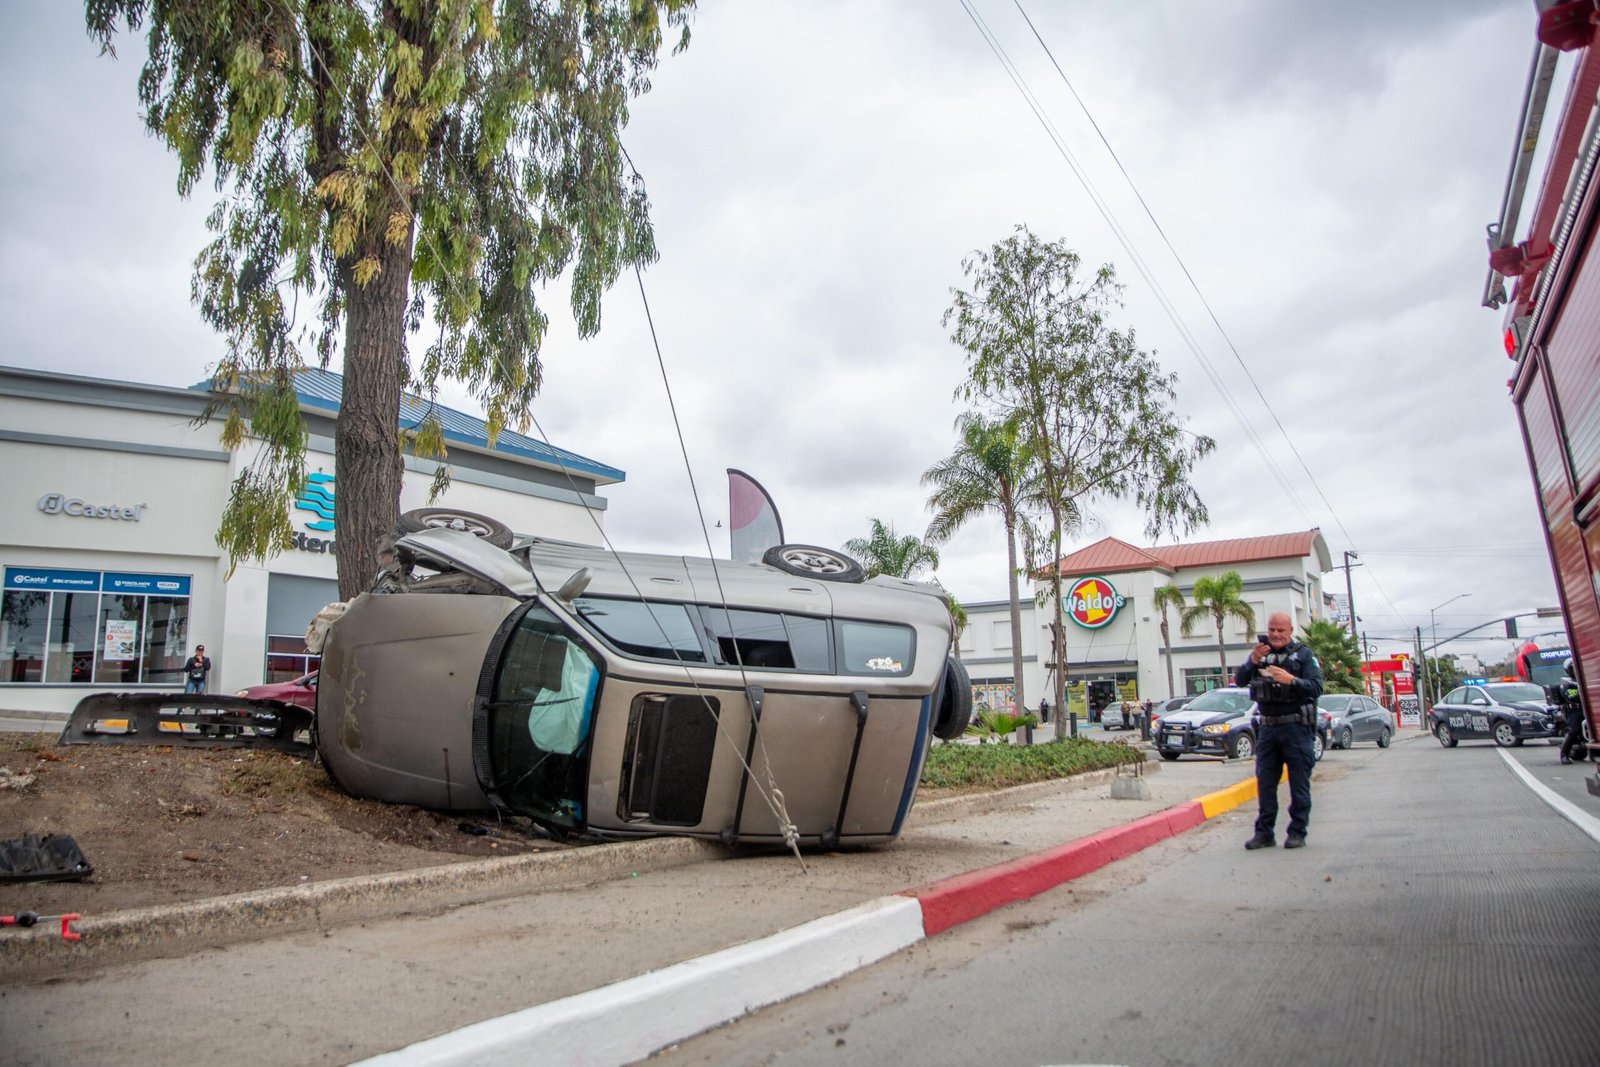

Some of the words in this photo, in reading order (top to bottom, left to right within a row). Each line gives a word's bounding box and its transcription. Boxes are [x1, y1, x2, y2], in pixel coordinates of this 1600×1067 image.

[63, 497, 142, 522] Castel
[288, 531, 337, 554] Stere
[1062, 591, 1125, 612] Waldo's
[1449, 717, 1465, 728] POLICIA
